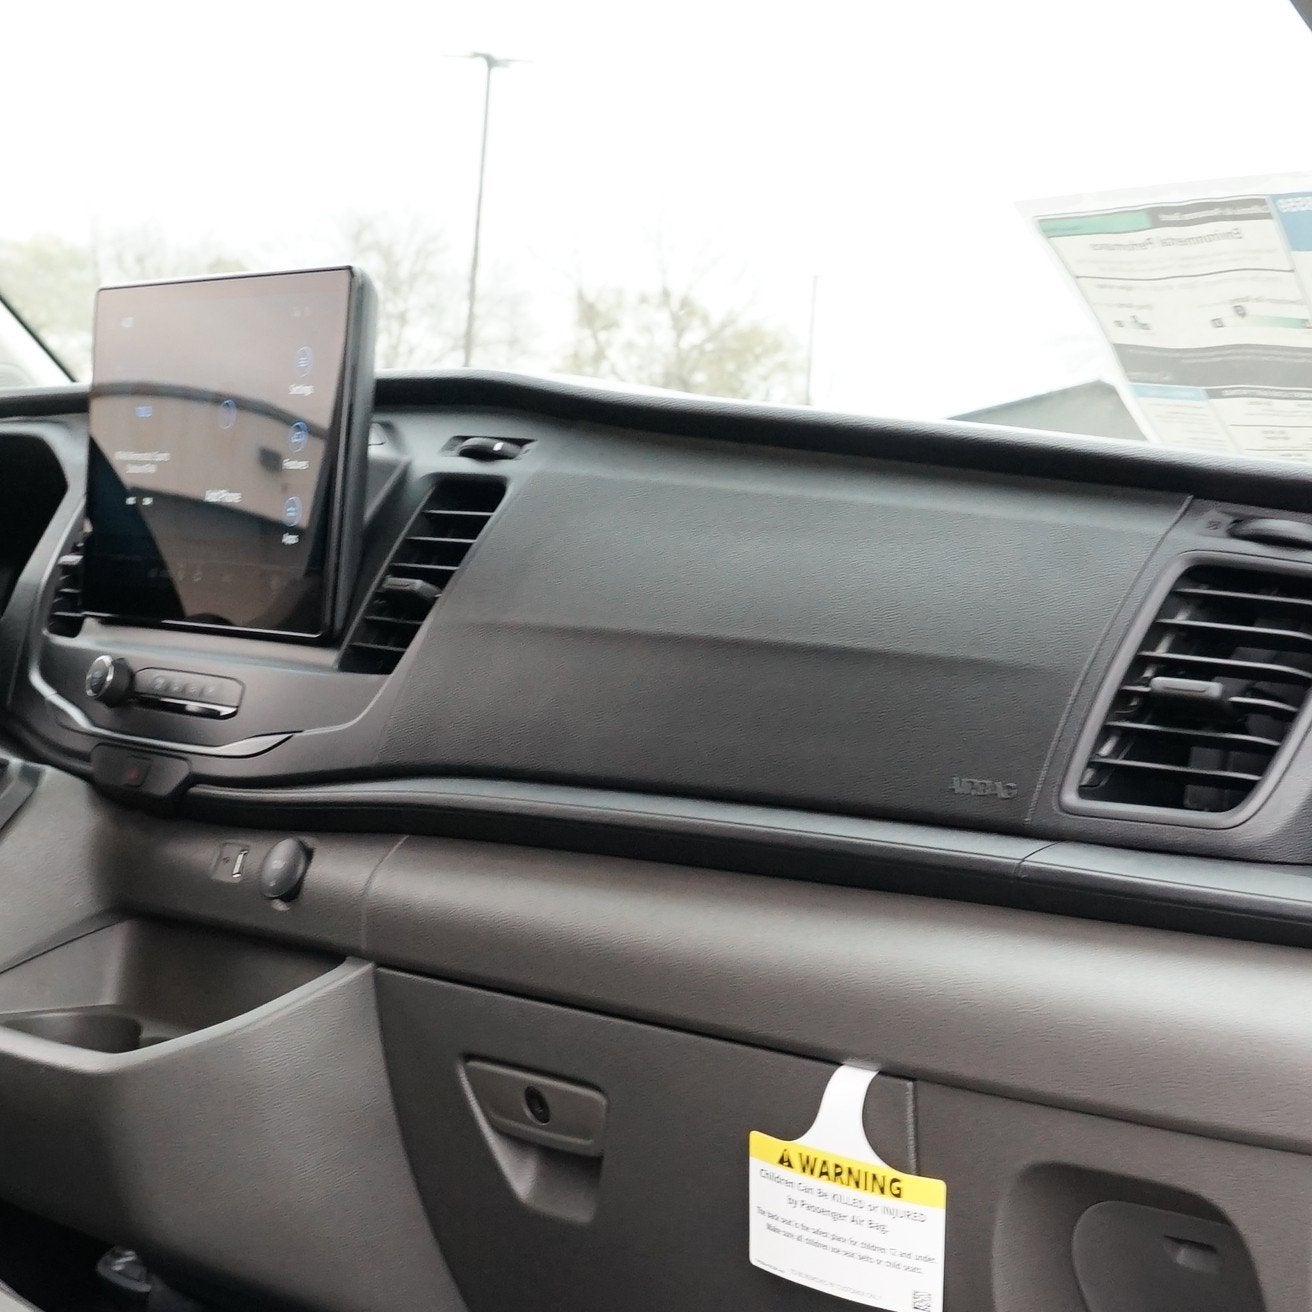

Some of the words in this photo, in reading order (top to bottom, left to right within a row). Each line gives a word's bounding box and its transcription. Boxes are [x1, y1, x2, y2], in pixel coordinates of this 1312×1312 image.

[760, 1168, 795, 1188] Children
[881, 1205, 927, 1223] INJURED
[798, 1152, 903, 1199] WARNING
[800, 1199, 848, 1222] Passenger
